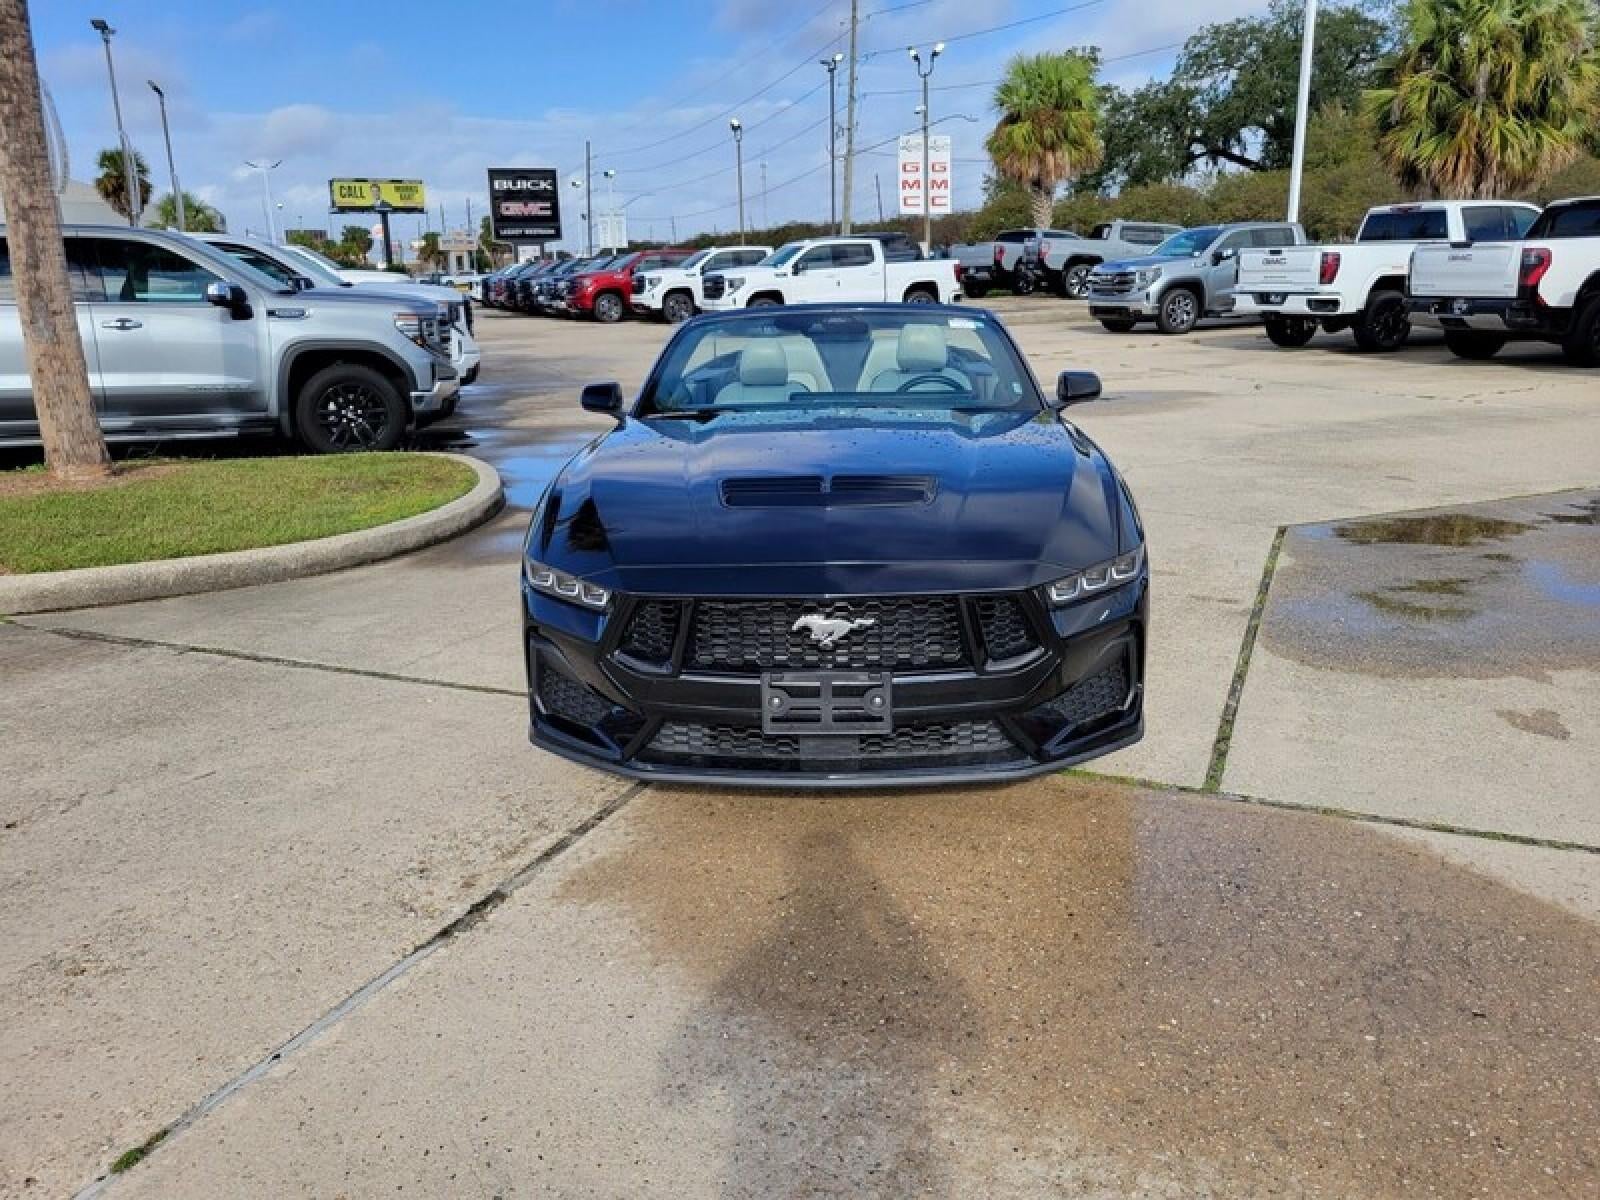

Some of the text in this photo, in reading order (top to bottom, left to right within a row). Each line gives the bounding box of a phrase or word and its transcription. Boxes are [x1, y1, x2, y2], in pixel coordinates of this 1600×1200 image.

[492, 179, 552, 190] BUICK
[902, 162, 920, 206] GMC
[931, 162, 948, 206] GMC
[339, 185, 366, 199] CALL
[498, 201, 552, 216] GMC
